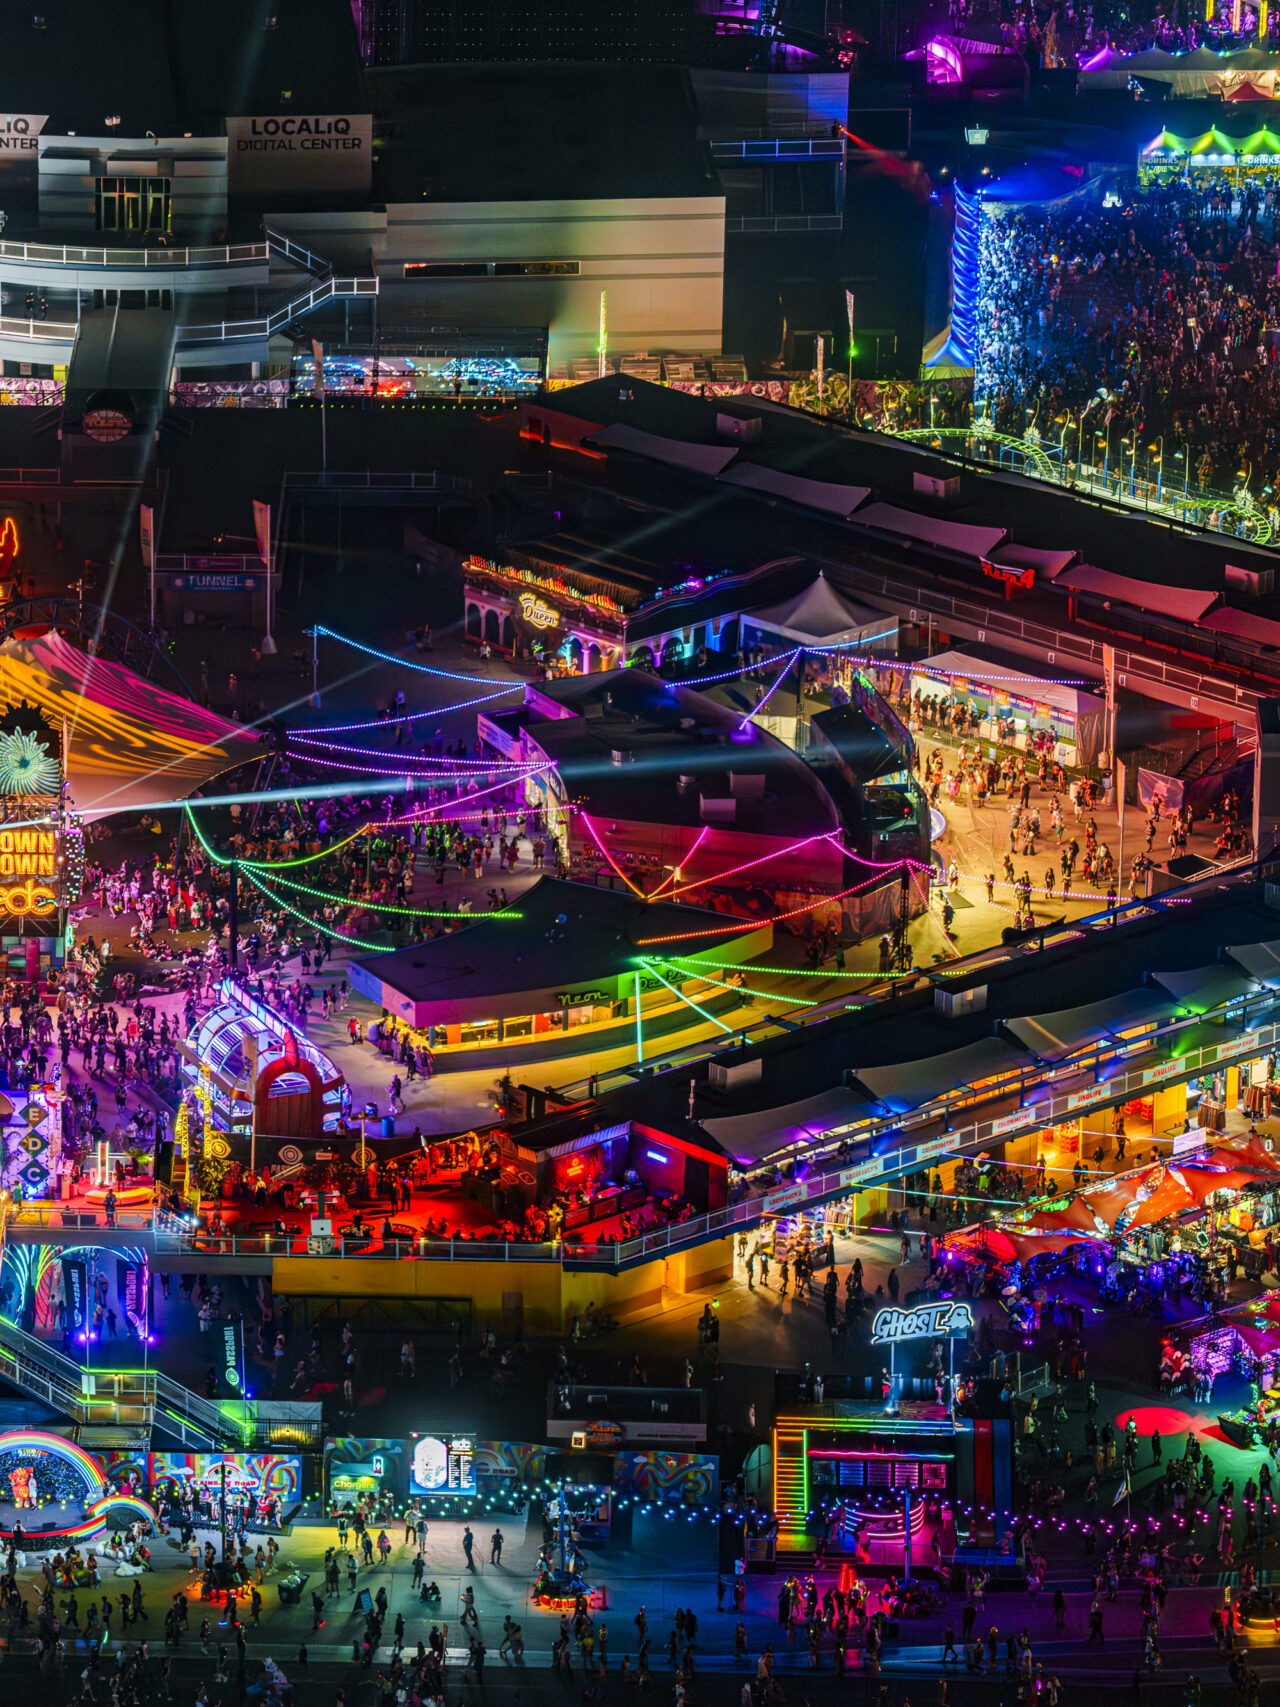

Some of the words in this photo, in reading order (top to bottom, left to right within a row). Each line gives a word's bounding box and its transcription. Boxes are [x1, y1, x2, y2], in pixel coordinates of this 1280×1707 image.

[251, 118, 351, 136] LOCALiQ
[237, 139, 297, 151] DIGITAL
[300, 137, 362, 151] CENTER
[1248, 156, 1280, 165] DRINKS
[189, 575, 243, 587] TUNNEL
[524, 604, 558, 627] Queen
[557, 991, 610, 1007] Neon
[26, 1107, 42, 1182] EDC
[874, 1304, 951, 1343] GHOST
[333, 1480, 376, 1490] Chargers
